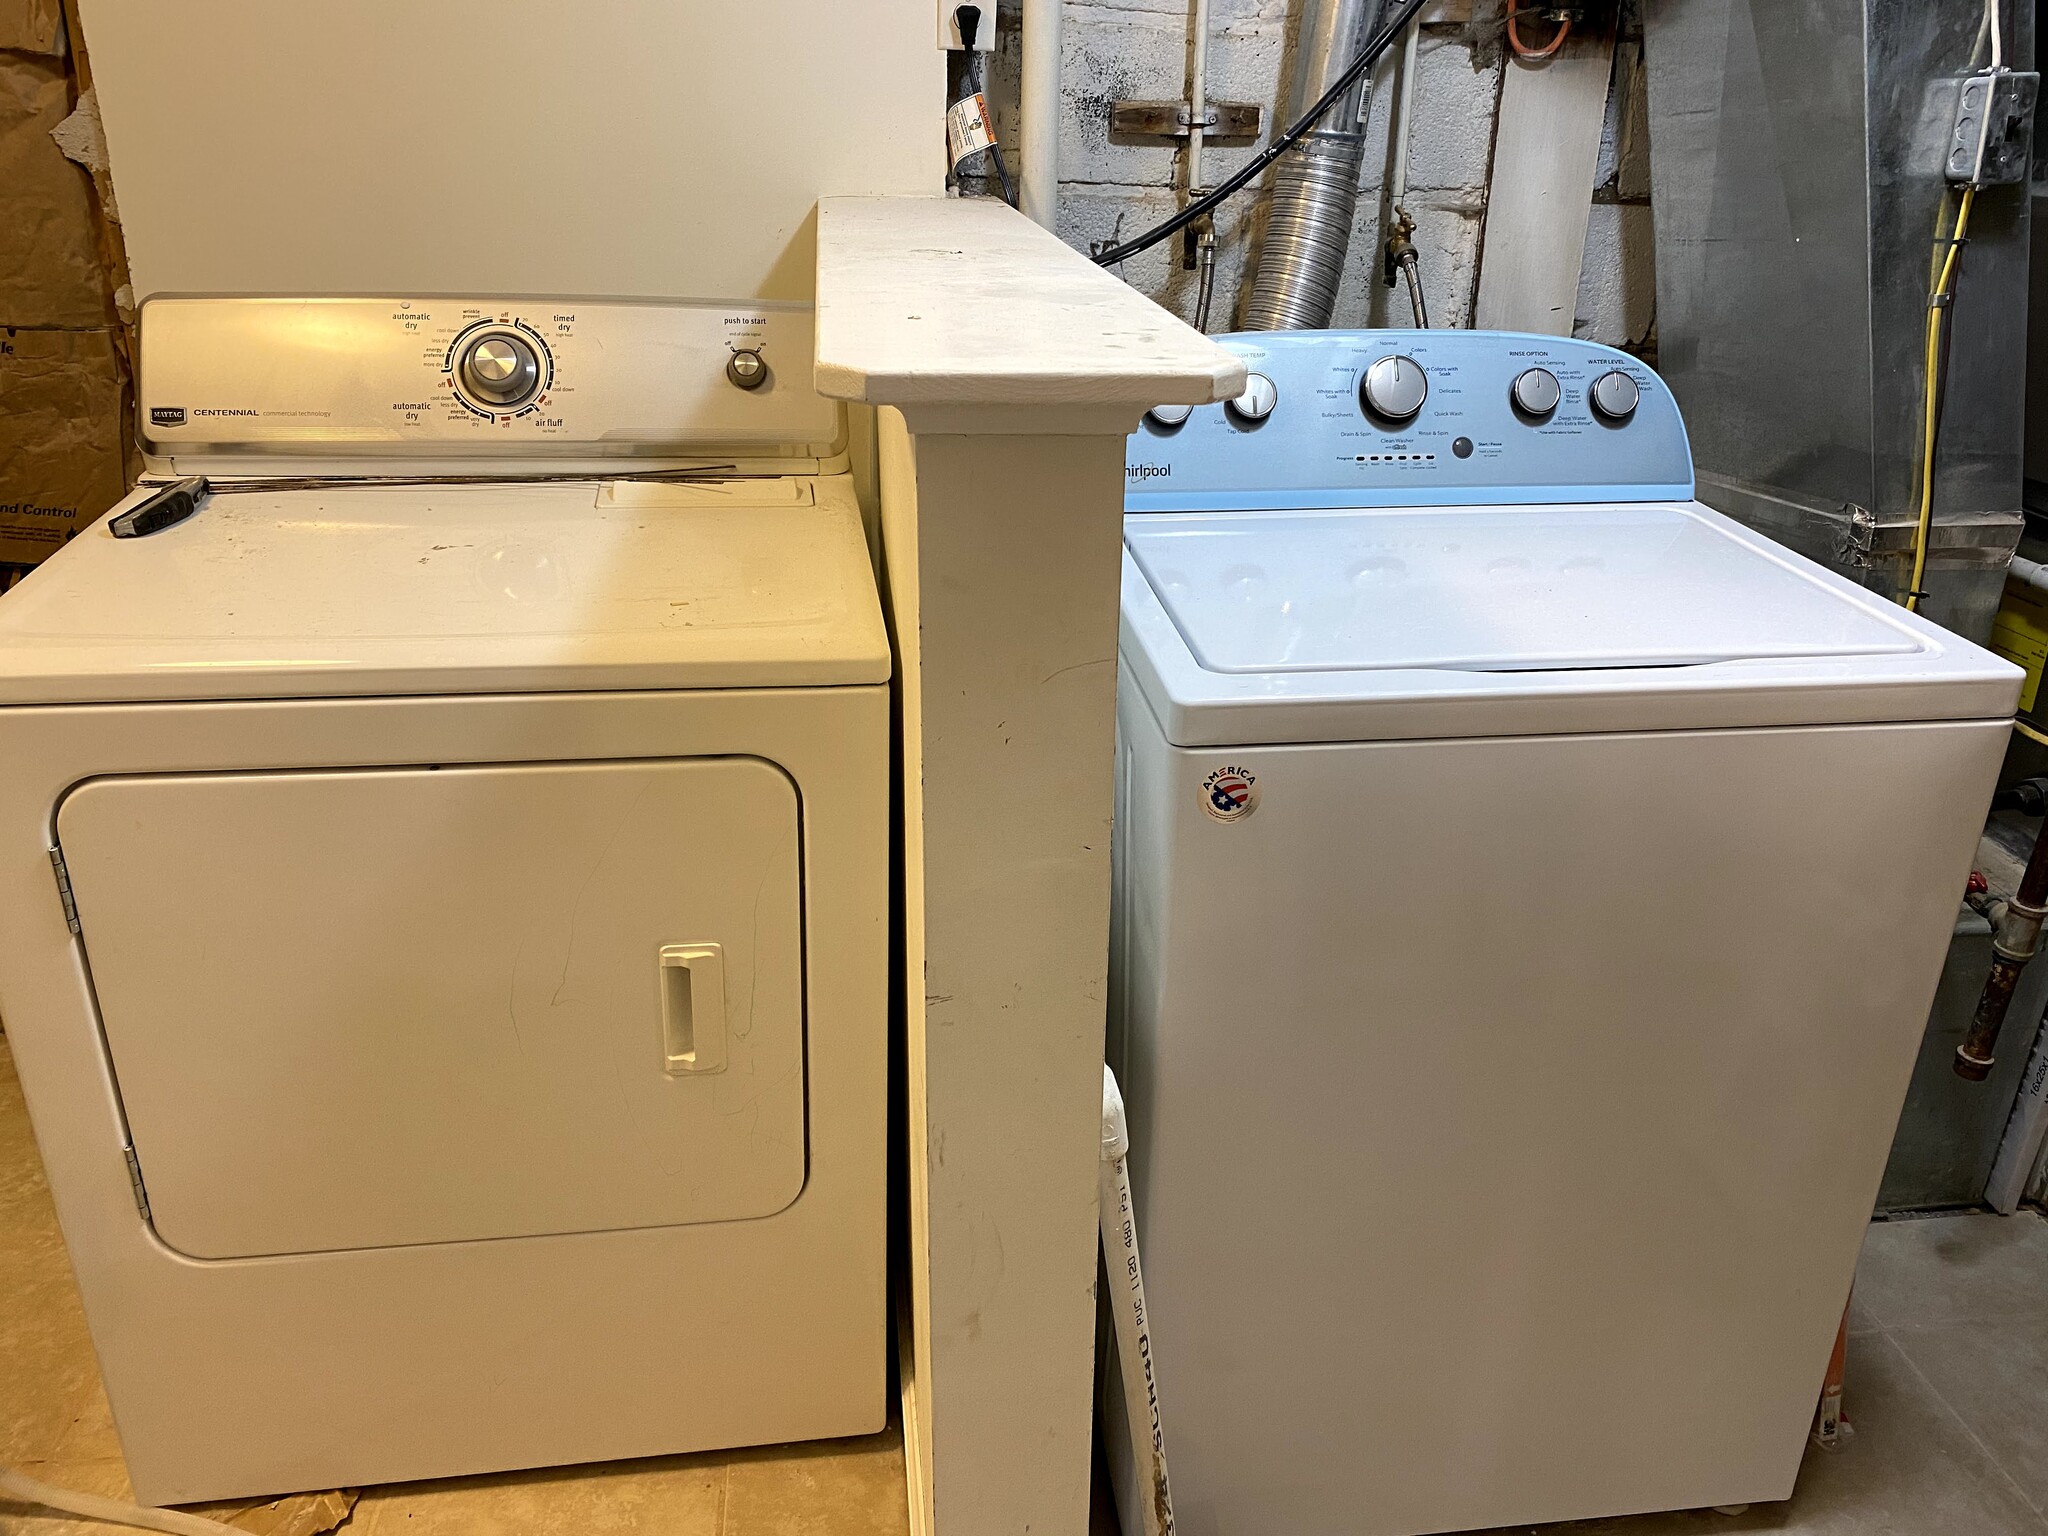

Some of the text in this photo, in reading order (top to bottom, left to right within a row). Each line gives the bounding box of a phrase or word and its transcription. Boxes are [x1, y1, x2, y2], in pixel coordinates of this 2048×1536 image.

[553, 314, 575, 322] timed
[724, 317, 741, 325] push
[405, 322, 418, 330] dry
[558, 324, 571, 332] dry
[392, 402, 431, 410] automatic
[298, 410, 331, 418] technology
[405, 412, 419, 421] dry
[547, 419, 563, 427] fluff
[1125, 463, 1171, 481] irlpool
[23, 504, 77, 518] Control
[1203, 766, 1256, 791] AMERICA
[1122, 1220, 1133, 1249] 480
[1127, 1255, 1140, 1291] 1120
